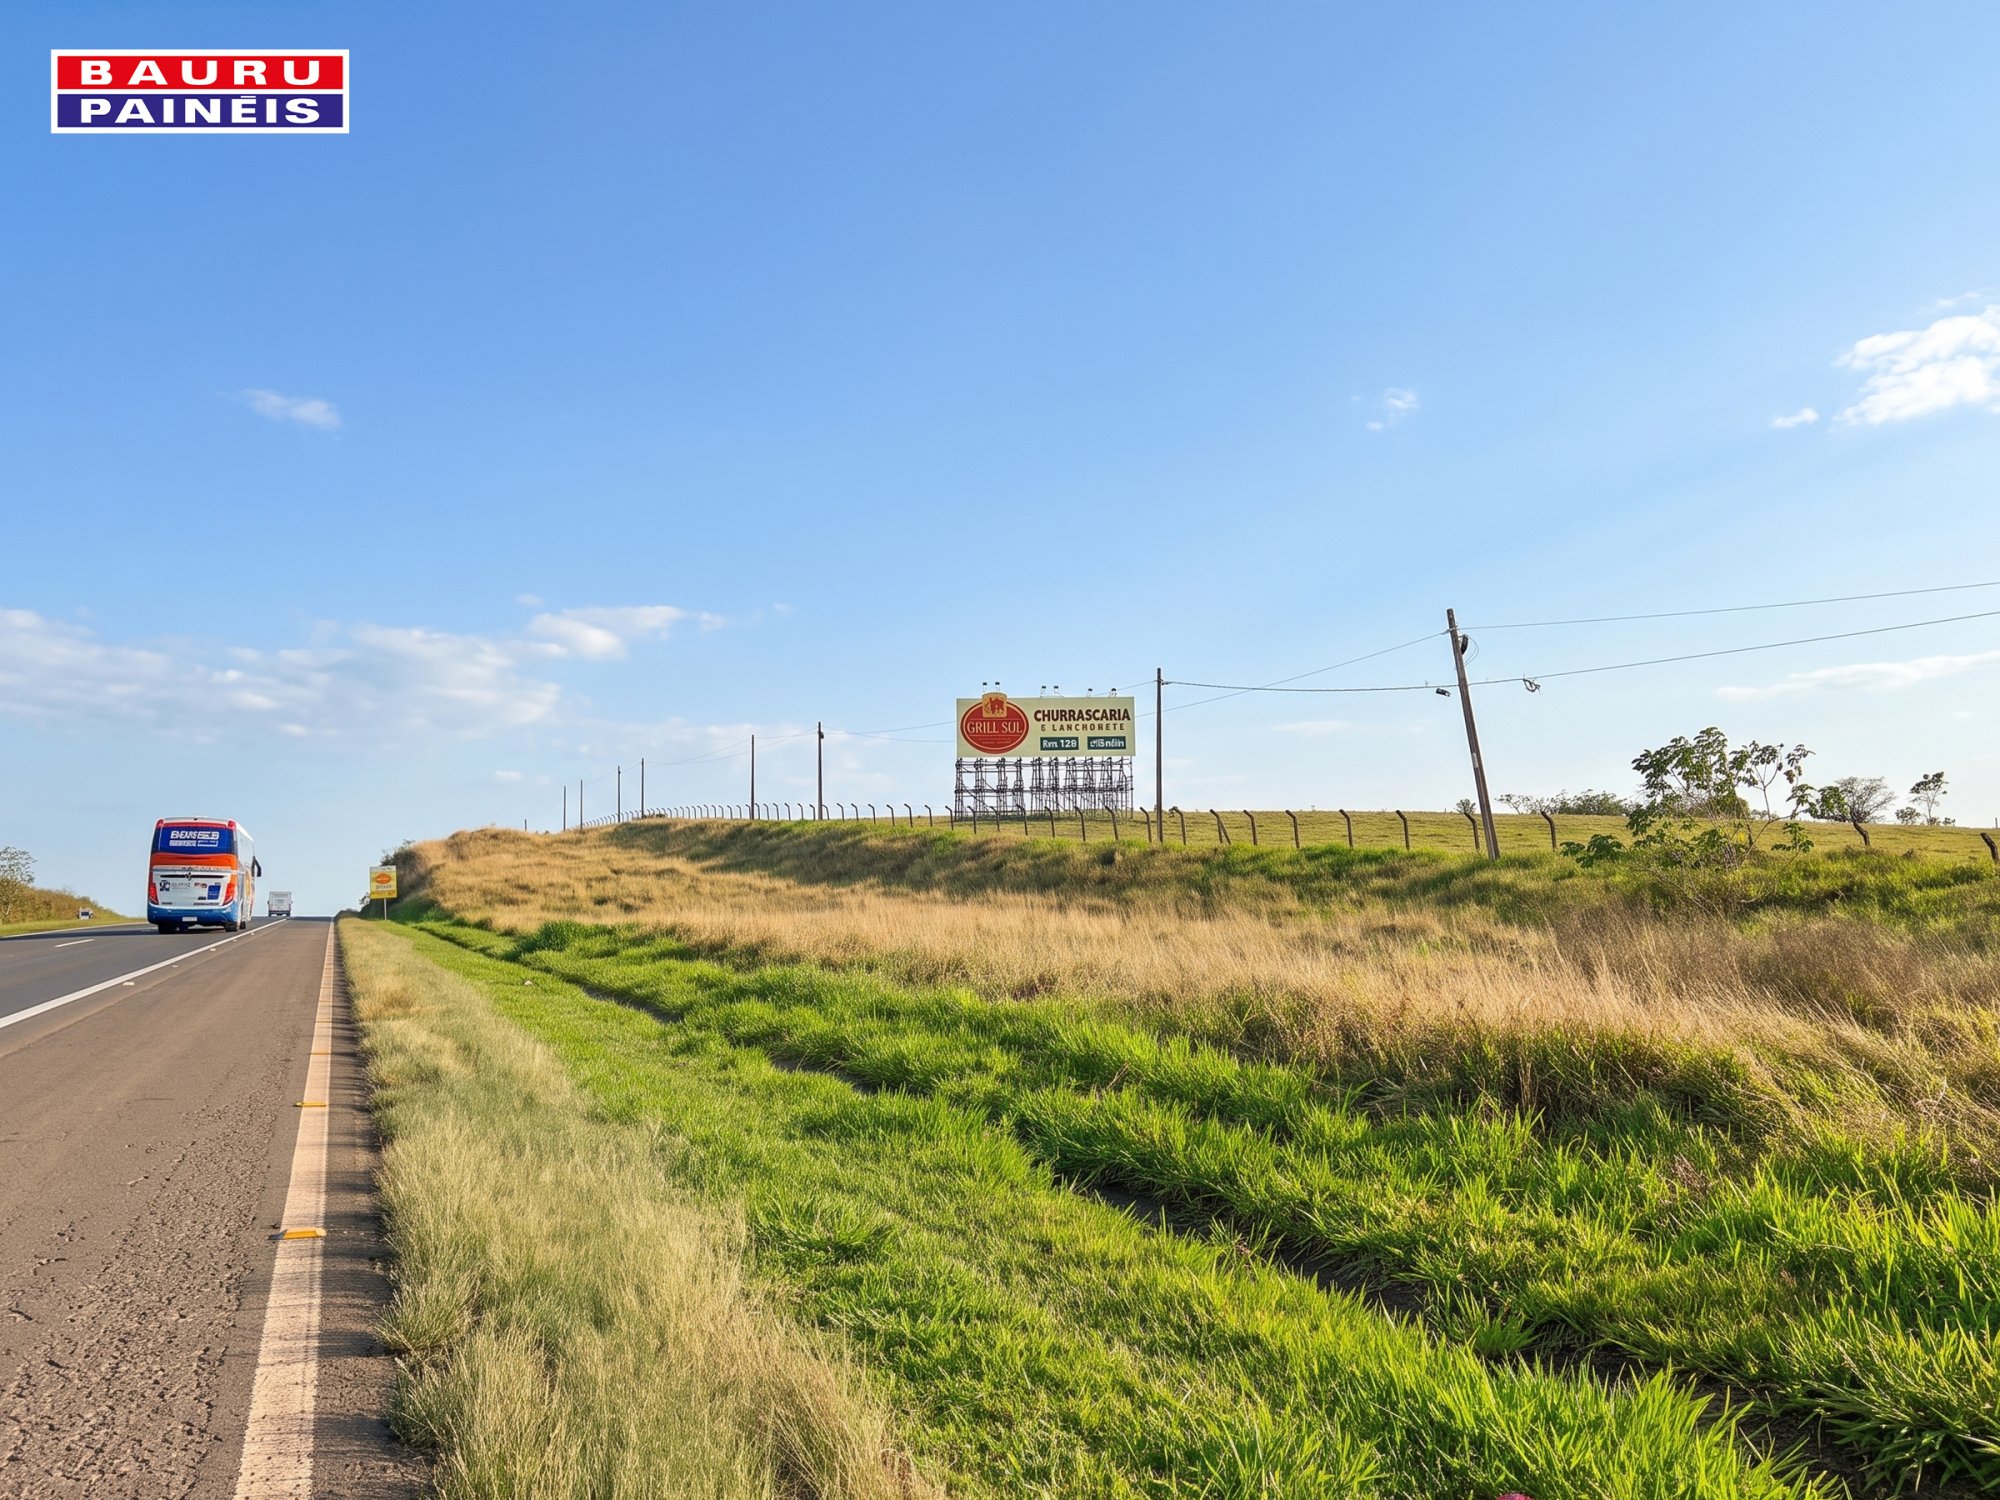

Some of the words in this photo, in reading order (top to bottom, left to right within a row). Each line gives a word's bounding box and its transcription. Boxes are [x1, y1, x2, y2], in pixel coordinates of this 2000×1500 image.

[1033, 708, 1131, 722] CHURRASCARIA
[967, 721, 999, 734] GRILL
[1001, 721, 1023, 734] SUL
[1060, 739, 1077, 748] 128
